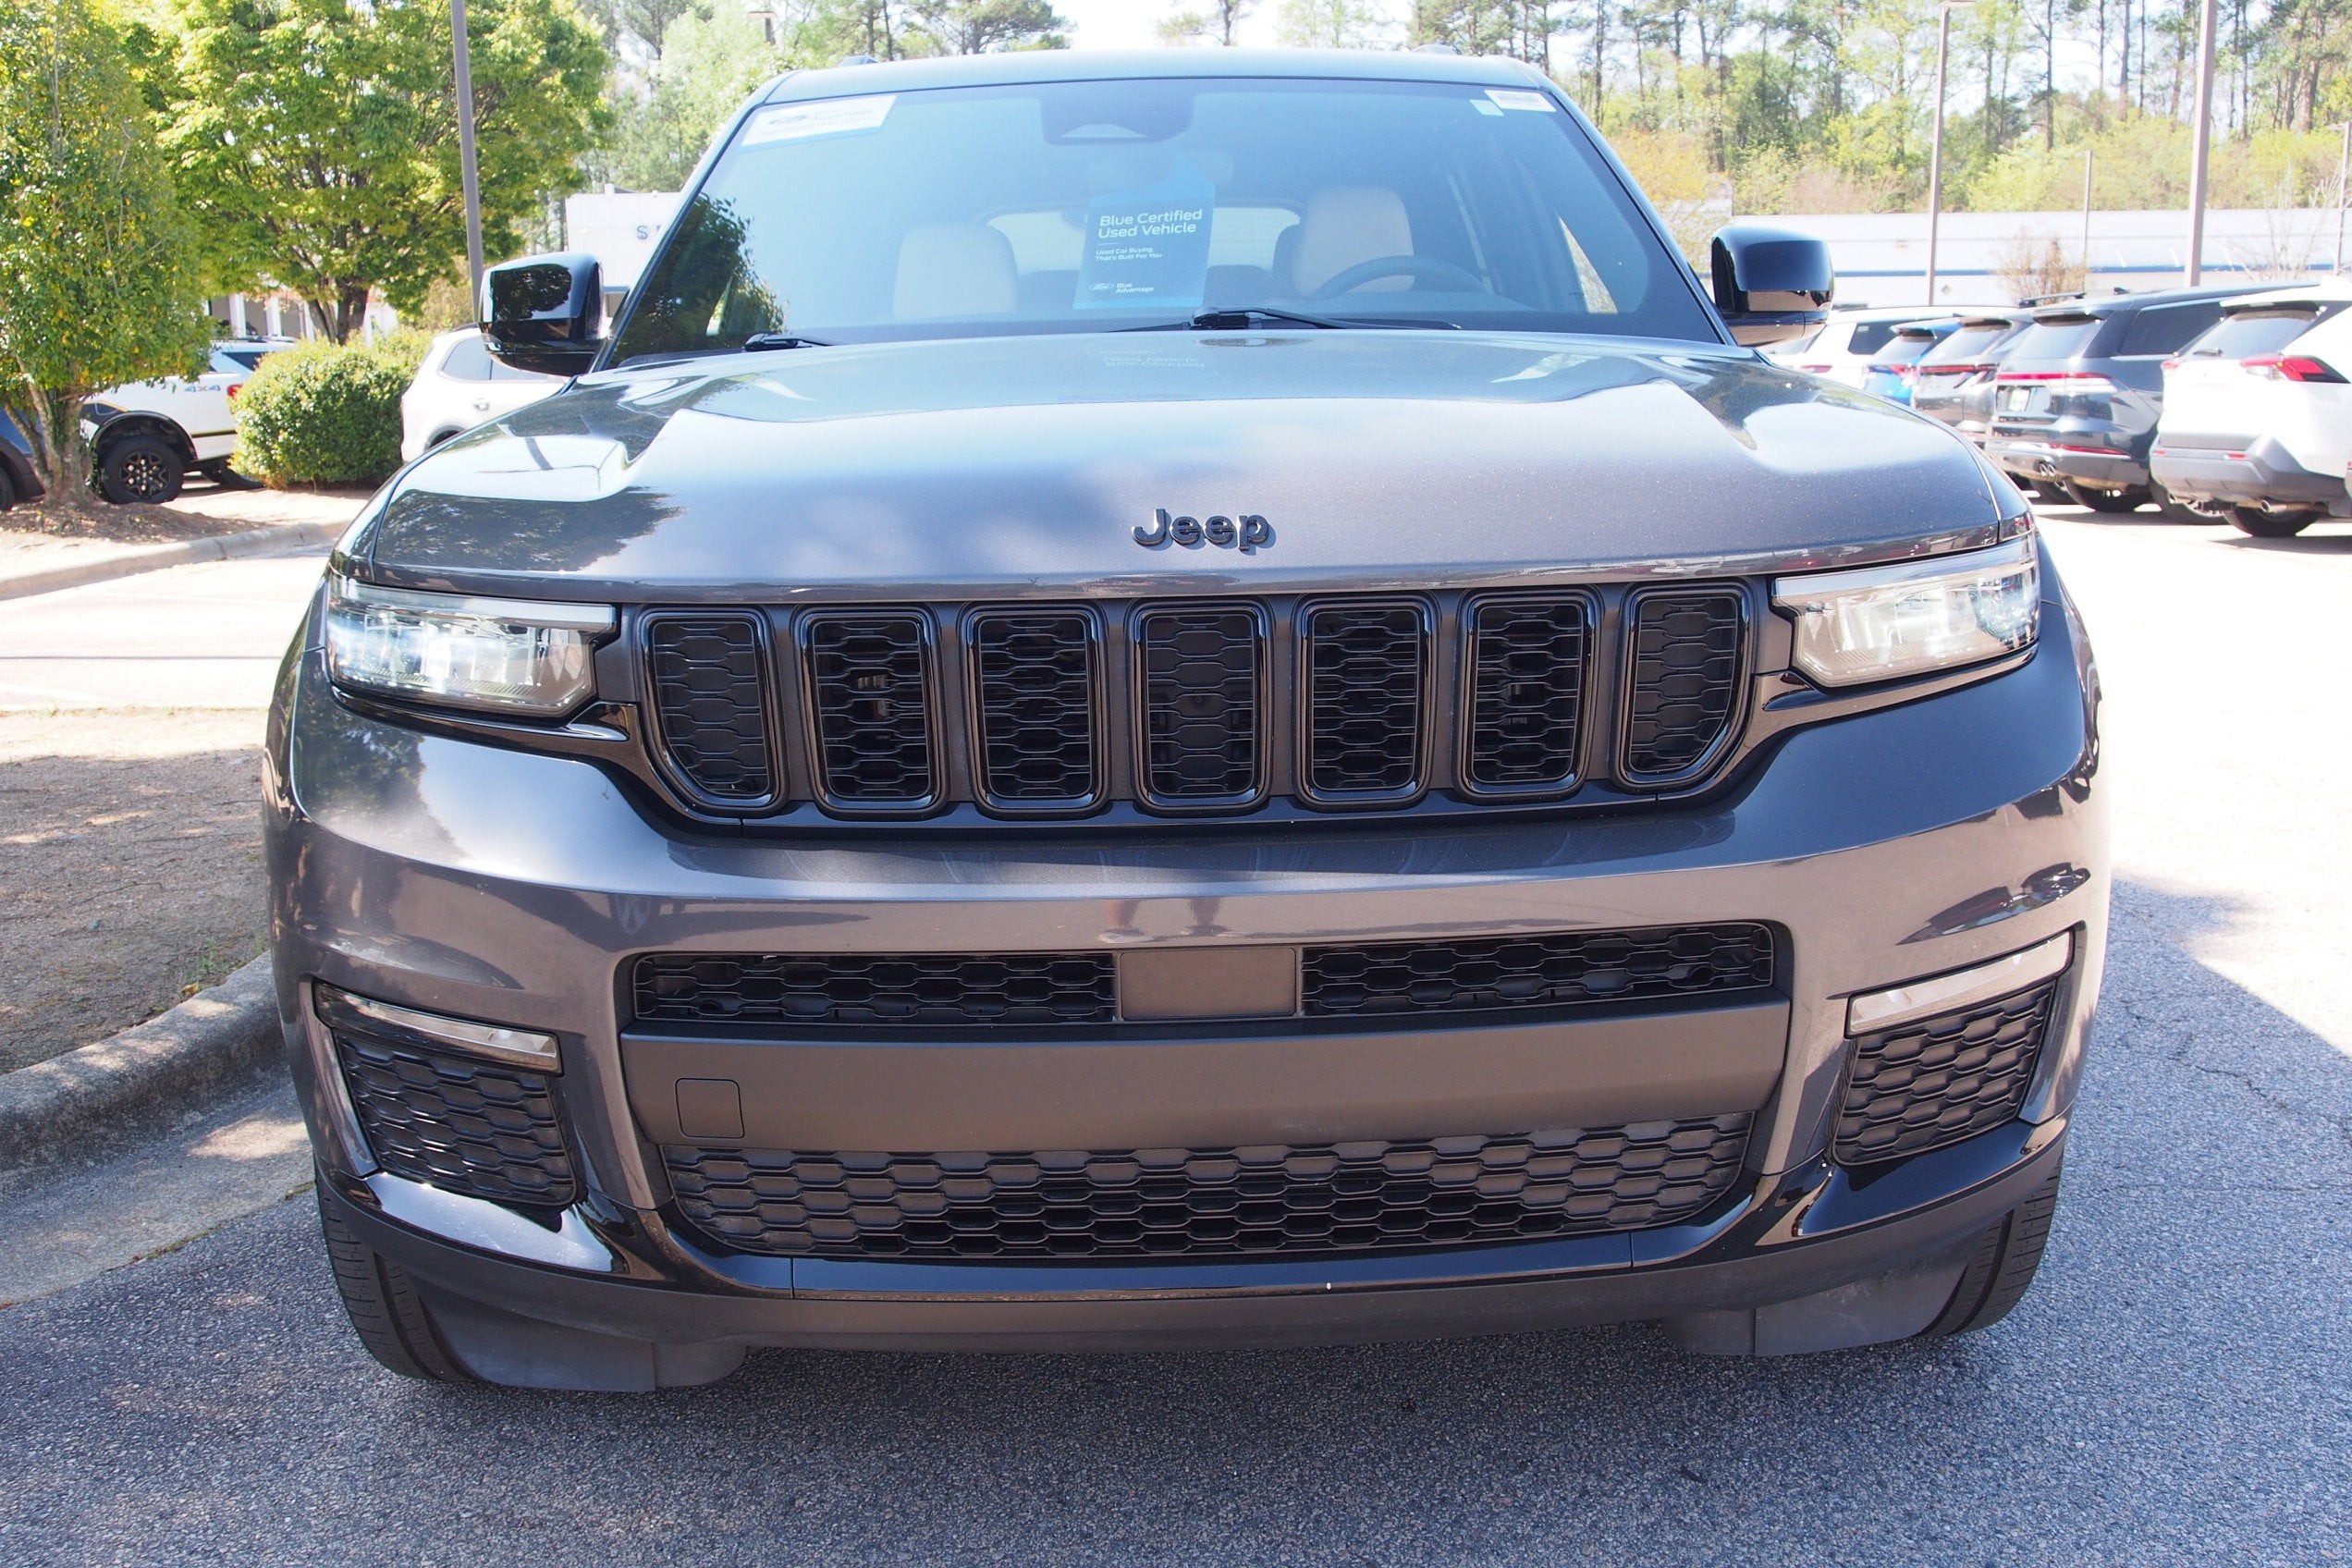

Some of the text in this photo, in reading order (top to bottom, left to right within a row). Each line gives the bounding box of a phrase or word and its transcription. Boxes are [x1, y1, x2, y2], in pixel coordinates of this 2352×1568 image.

[1100, 208, 1203, 227] Blue Certified
[1098, 222, 1196, 239] Used Vehicle
[1131, 508, 1271, 552] Jeep
